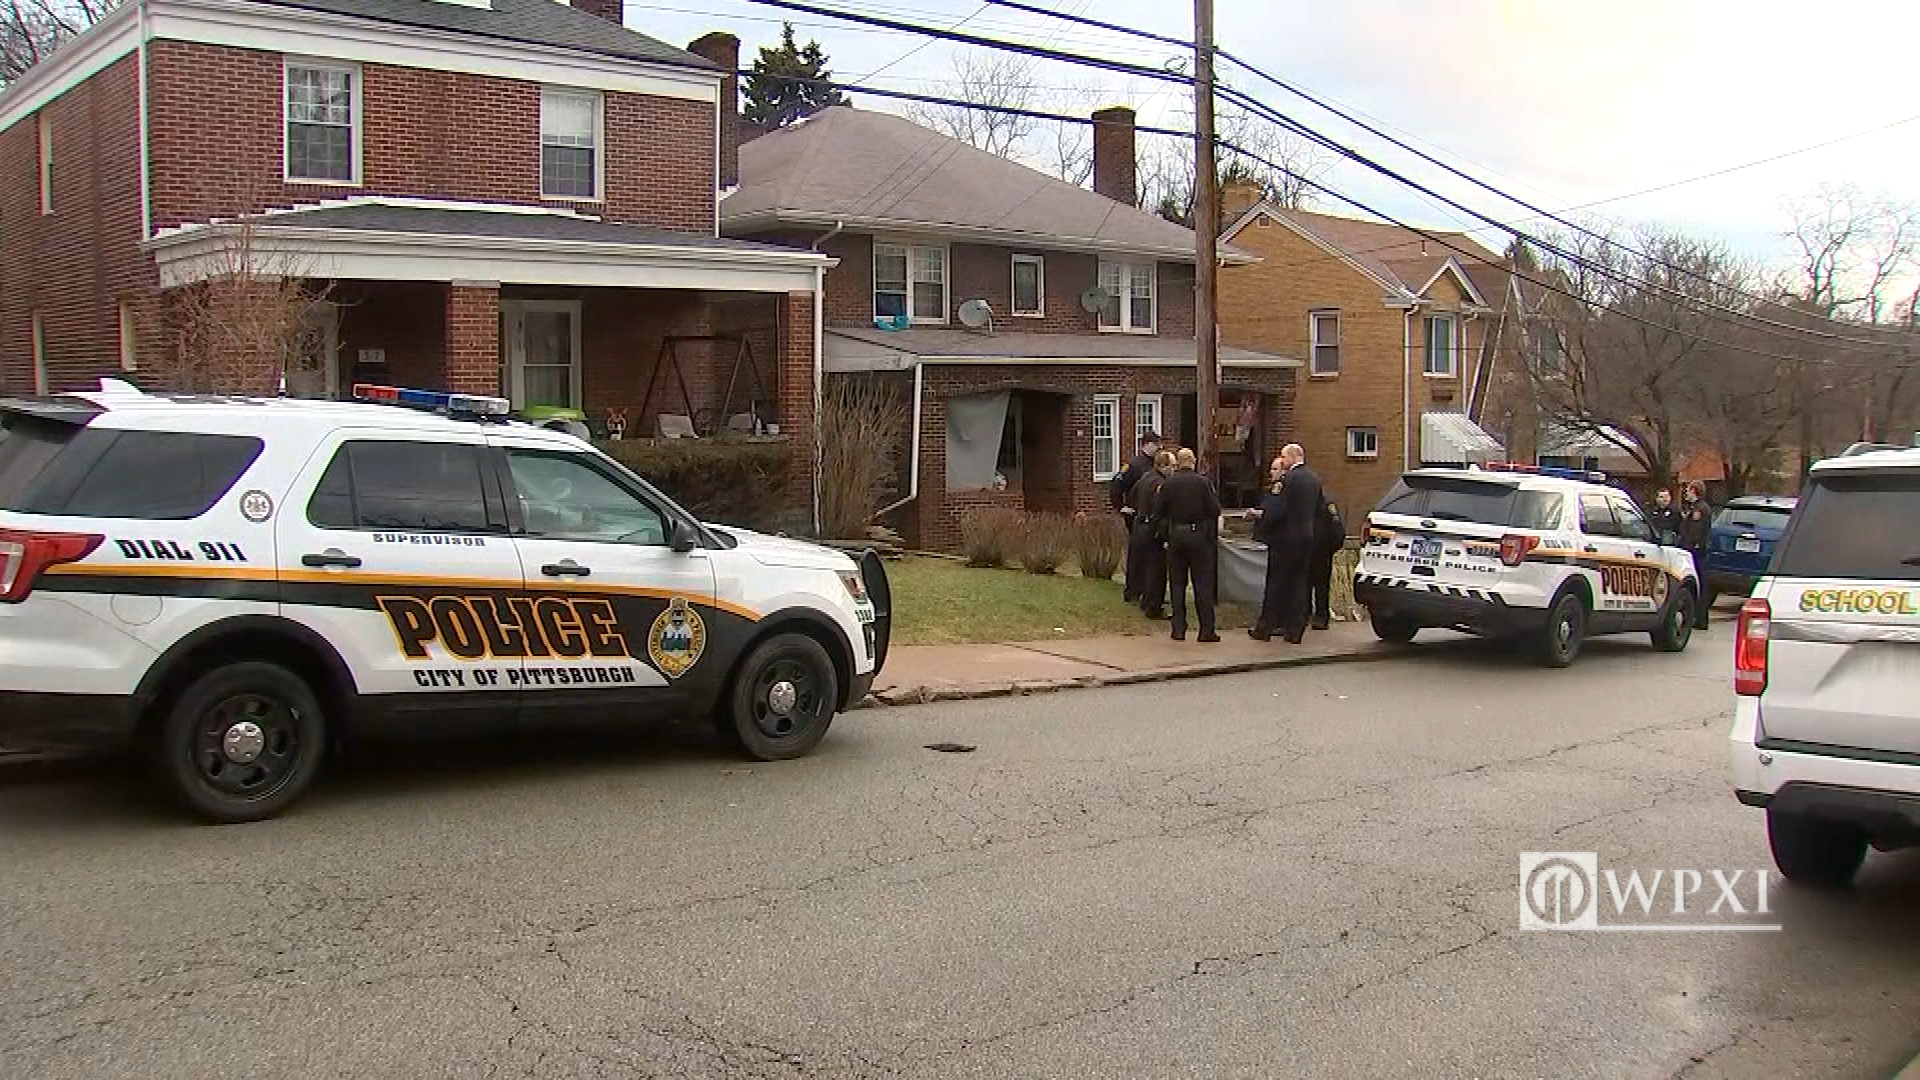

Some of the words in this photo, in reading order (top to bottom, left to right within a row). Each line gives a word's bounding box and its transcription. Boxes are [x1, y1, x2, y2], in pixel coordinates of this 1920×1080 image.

[114, 539, 195, 561] DIAL
[197, 541, 248, 562] 911
[372, 533, 486, 547] SUPERVISOR
[1365, 551, 1440, 567] PITTSBURGH
[1444, 561, 1498, 573] POLICE
[1600, 565, 1652, 597] POLICE
[1800, 590, 1920, 614] SCHOOL
[375, 595, 630, 661] POLICE
[412, 669, 466, 687] CITY
[472, 669, 499, 686] OF
[505, 666, 636, 685] PITTSBURGH
